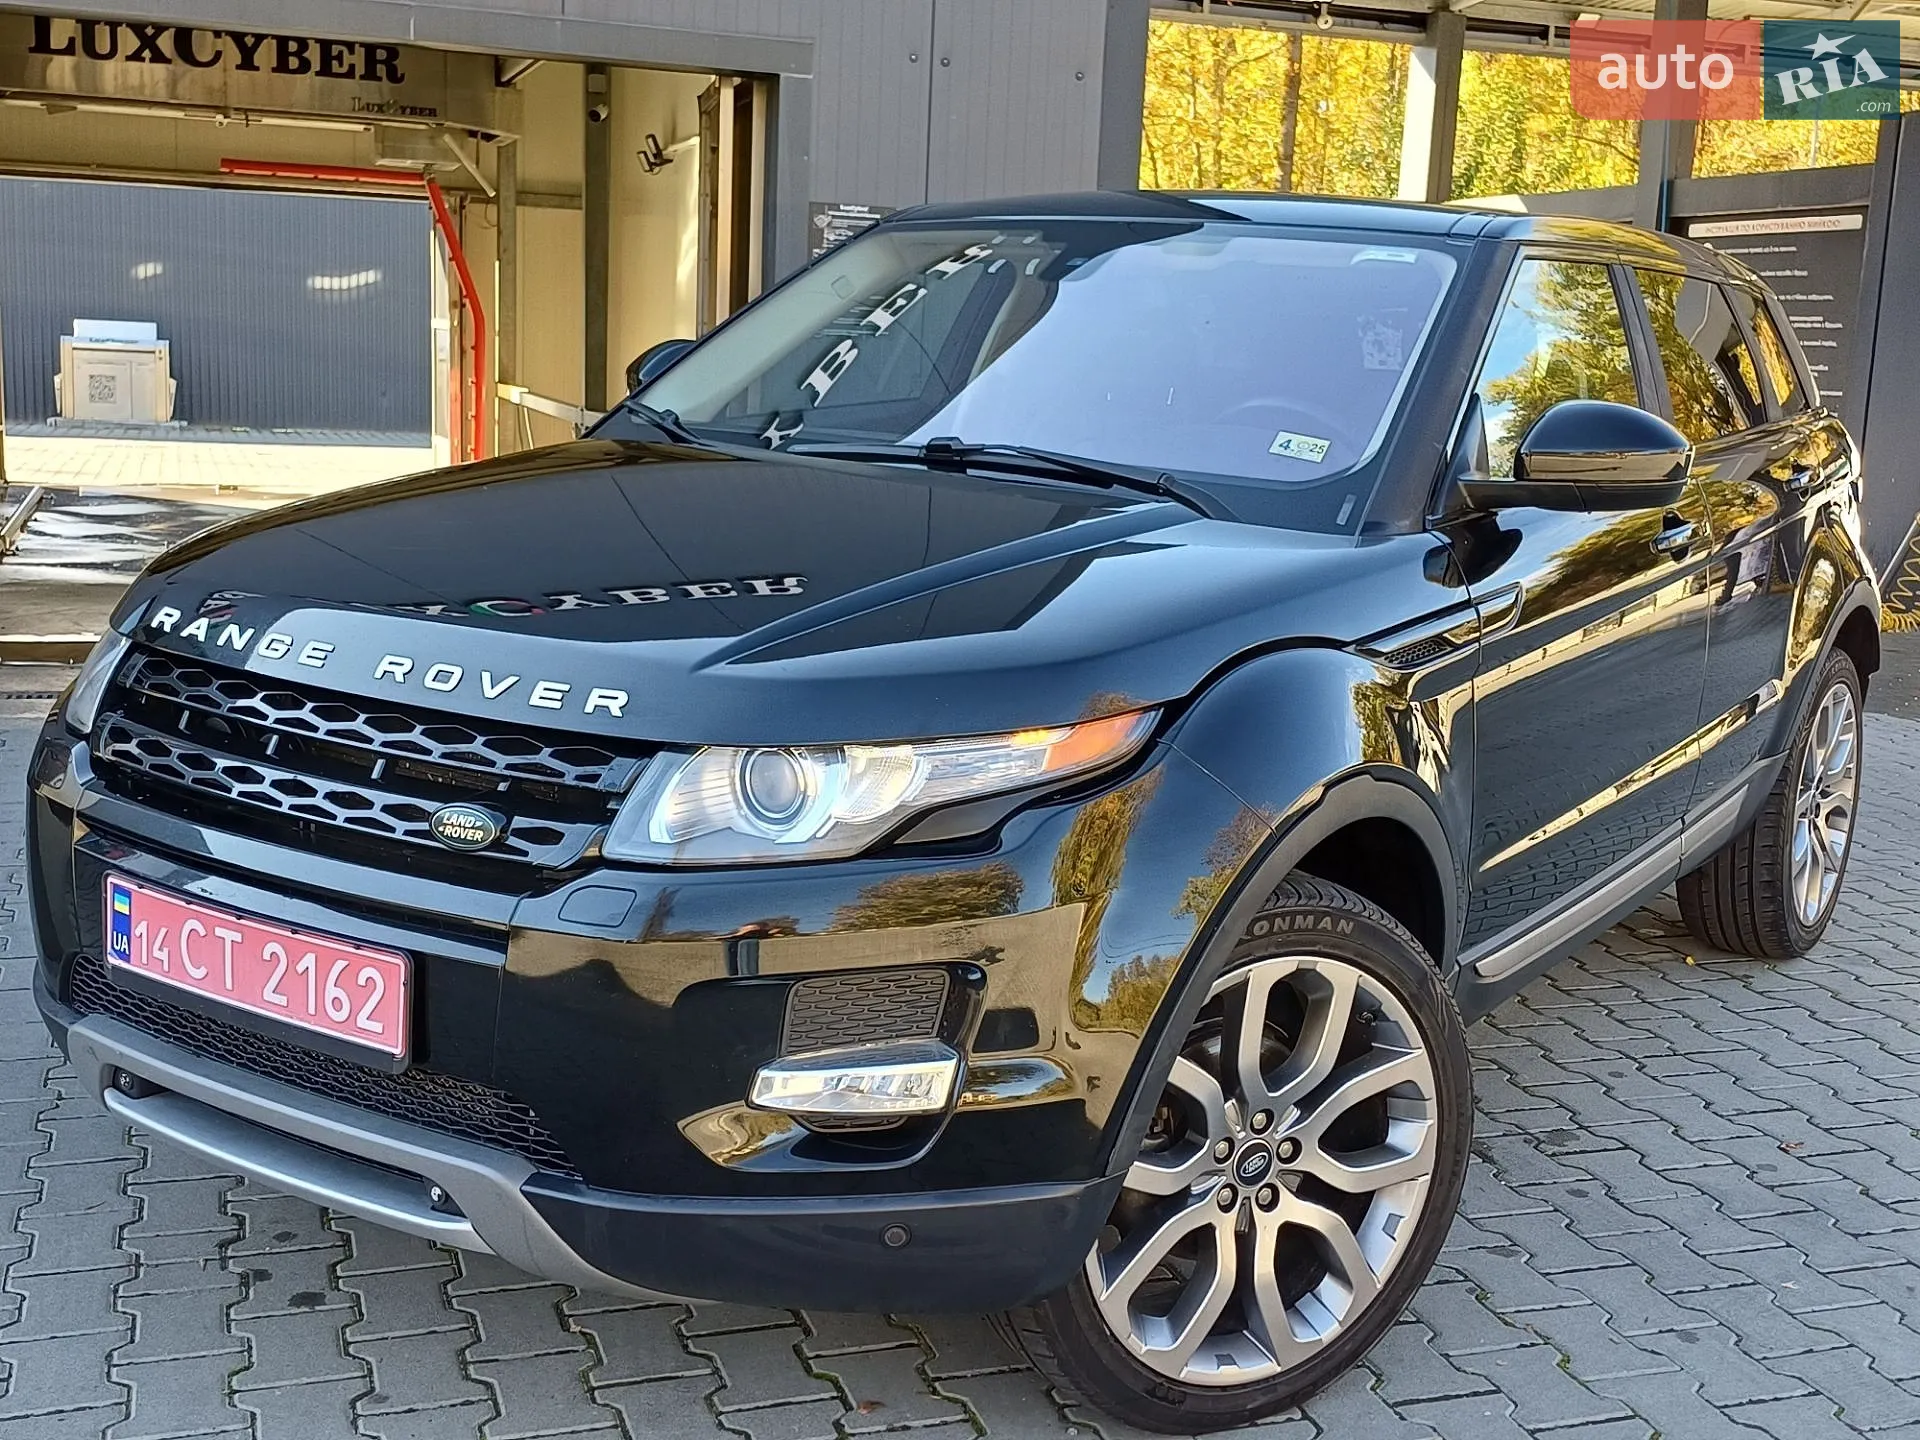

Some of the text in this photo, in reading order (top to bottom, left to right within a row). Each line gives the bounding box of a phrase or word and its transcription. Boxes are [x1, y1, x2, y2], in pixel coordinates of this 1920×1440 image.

[28, 15, 406, 84] LUXCYBER
[1309, 443, 1326, 454] 25
[150, 606, 630, 717] RANGE ROVER
[443, 811, 477, 828] LAND
[444, 824, 484, 842] ROVER
[1251, 914, 1355, 937] ONMAN
[113, 930, 130, 955] UA
[261, 941, 386, 1035] 2162
